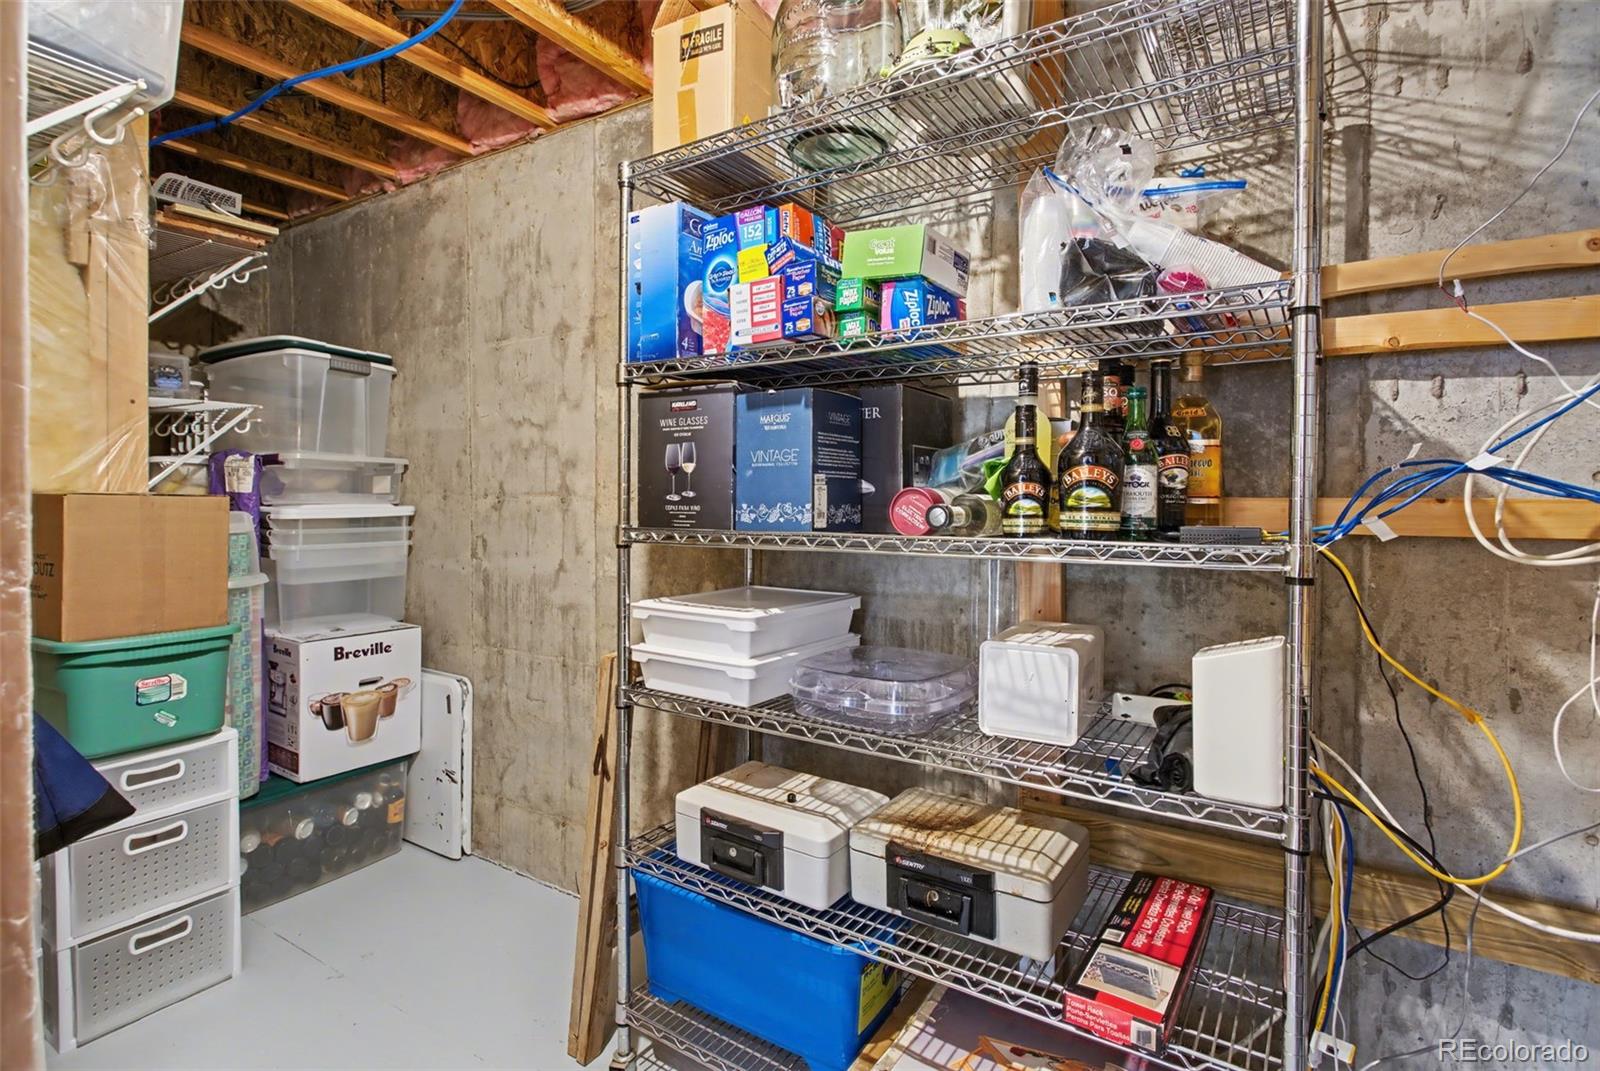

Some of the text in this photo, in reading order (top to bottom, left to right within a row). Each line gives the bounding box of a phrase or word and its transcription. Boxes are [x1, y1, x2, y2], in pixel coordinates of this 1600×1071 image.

[690, 28, 722, 48] FRAGILE
[744, 224, 762, 239] 152
[706, 231, 735, 251] Ziploc
[786, 286, 796, 295] 75
[904, 289, 921, 326] Ziploc
[926, 294, 951, 320] Ziploc
[784, 322, 794, 332] 75
[681, 336, 688, 350] 4
[672, 400, 696, 408] KIRKLAND
[660, 416, 708, 427] WINE GLASSES
[760, 412, 792, 424] MARQUIS
[750, 448, 800, 462] VINTAGE
[1064, 466, 1116, 484] BAILEYS
[1006, 482, 1046, 498] BAILEYS
[273, 644, 291, 658] Breville
[334, 642, 392, 662] Breville
[711, 820, 728, 830] SENTRY
[902, 859, 925, 870] SENTRY
[1067, 998, 1104, 1017] Towel Rack
[1089, 1020, 1104, 1032] Para
